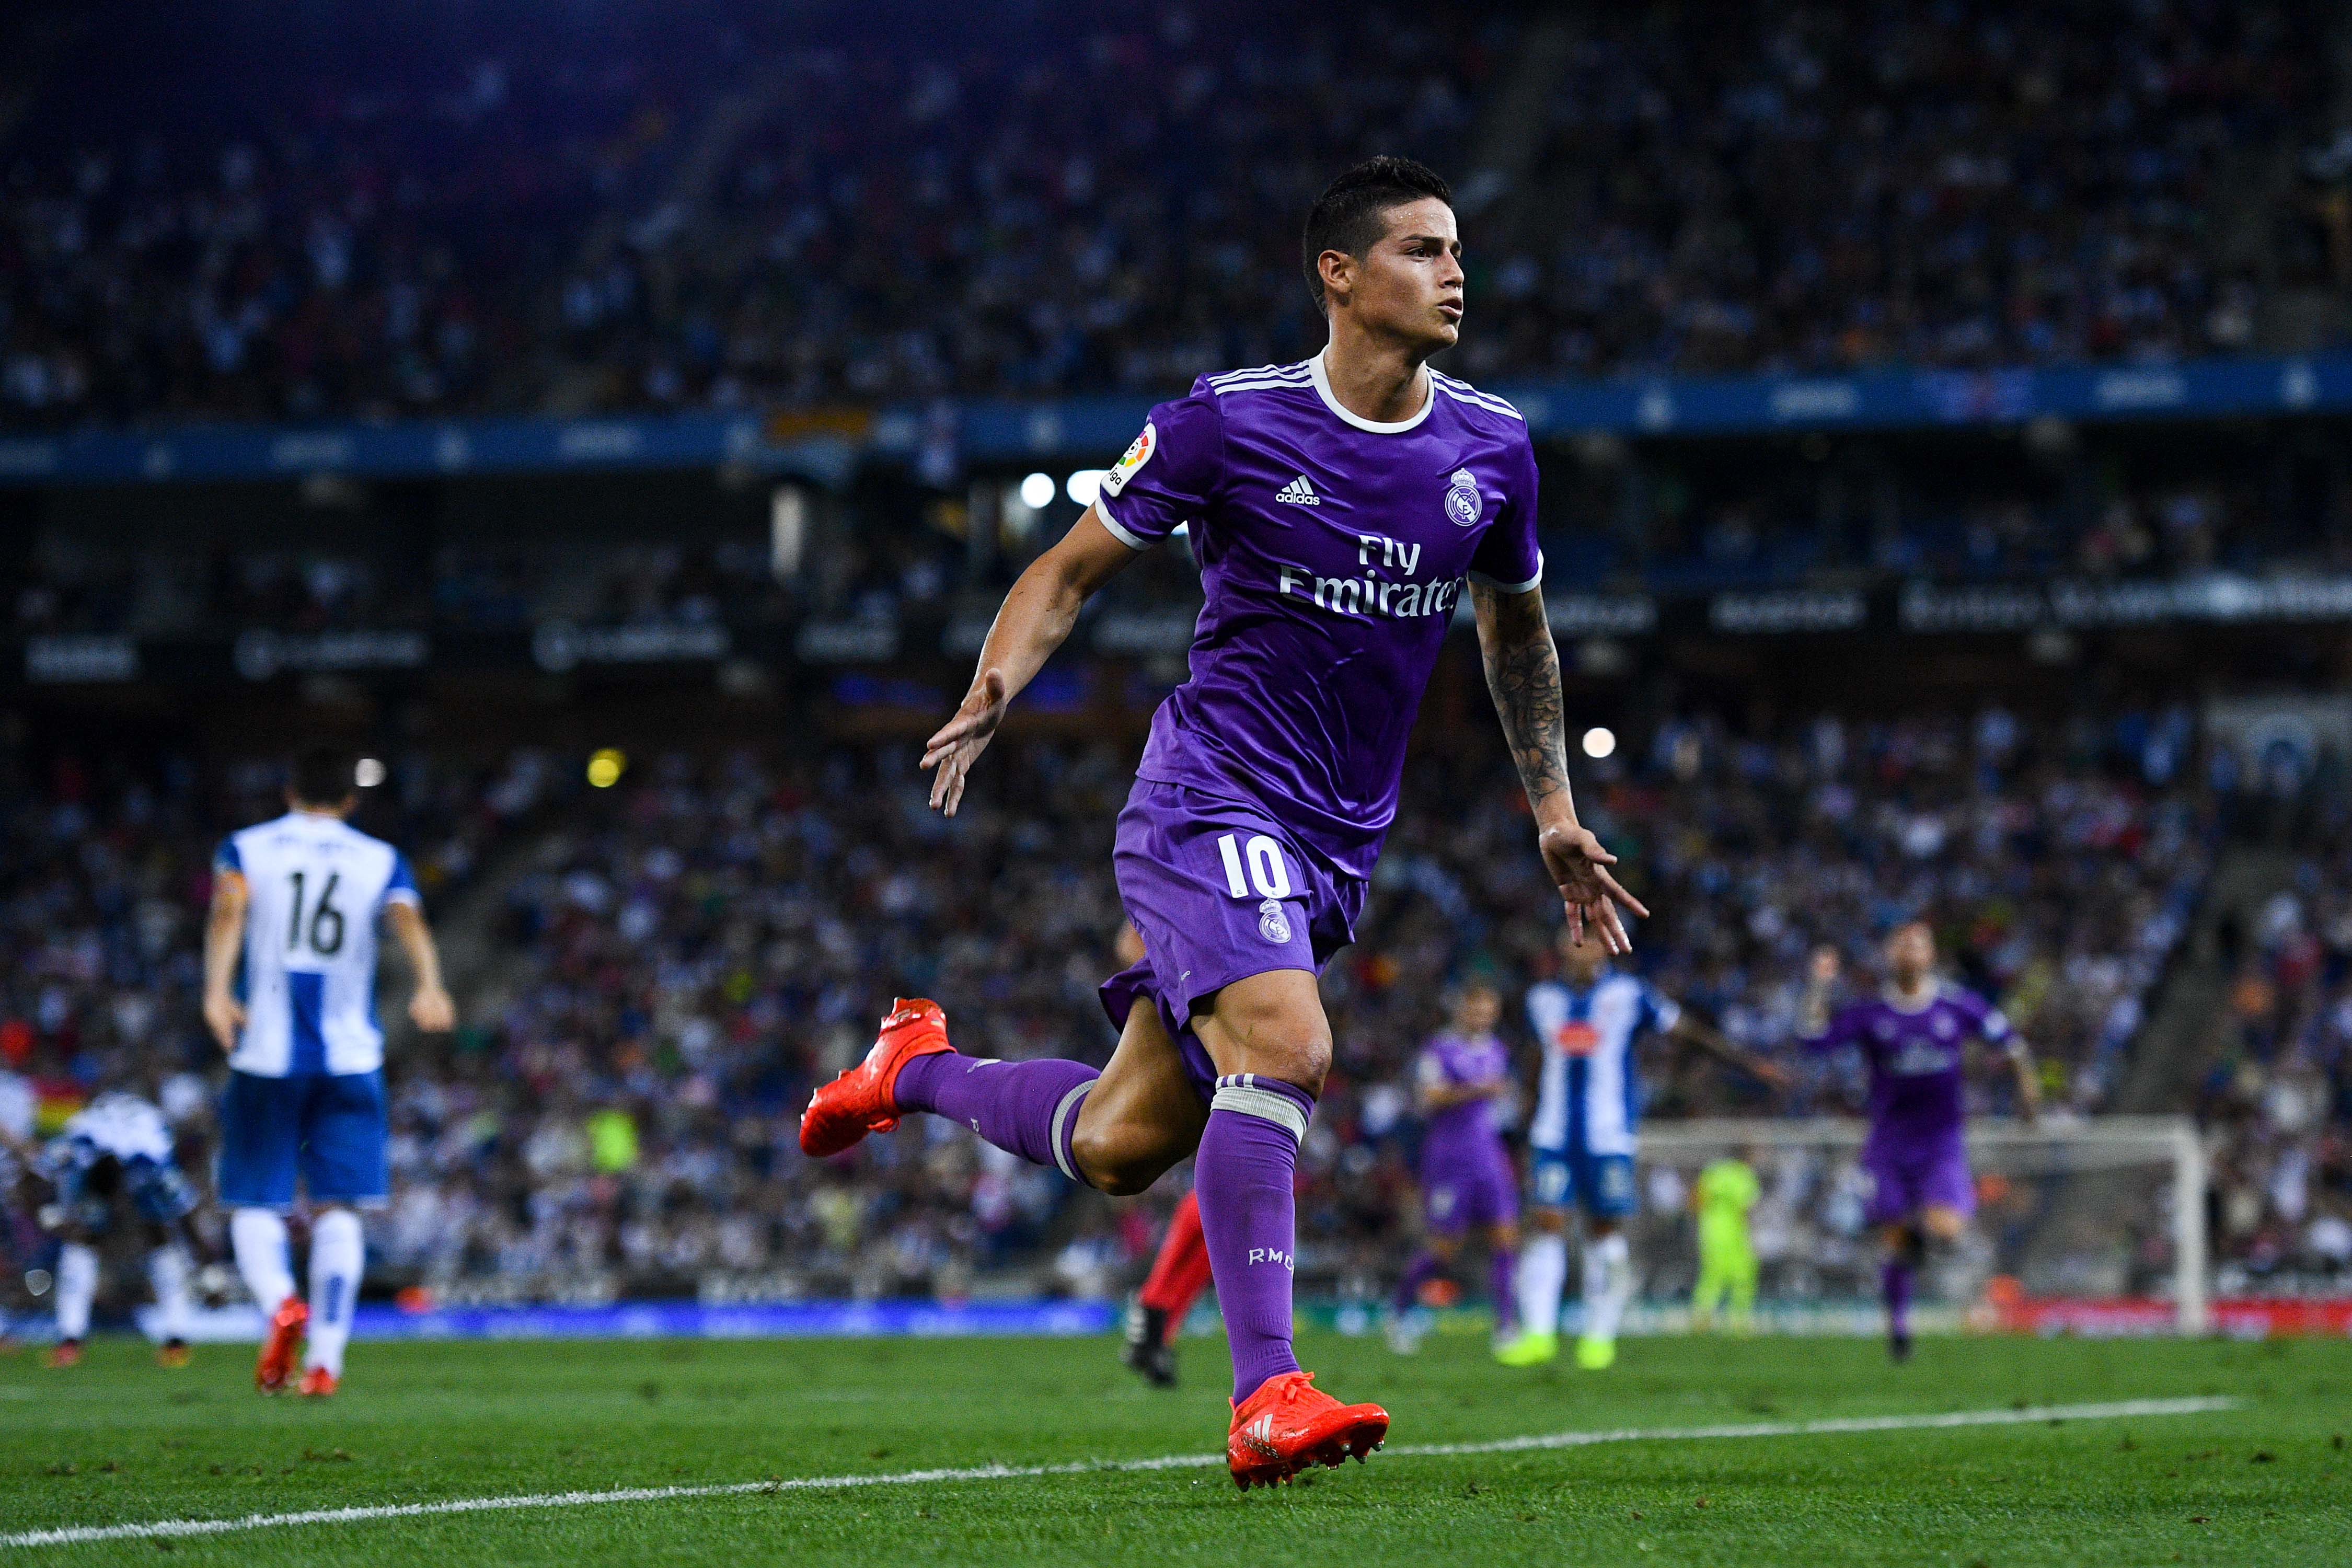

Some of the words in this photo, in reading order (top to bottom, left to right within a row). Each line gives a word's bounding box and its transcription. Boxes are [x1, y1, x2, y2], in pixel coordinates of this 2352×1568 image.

[1108, 467, 1122, 486] iga
[1275, 492, 1320, 505] adidas
[1359, 535, 1421, 575] Fly
[1217, 834, 1291, 899] 10
[285, 870, 345, 955] 16
